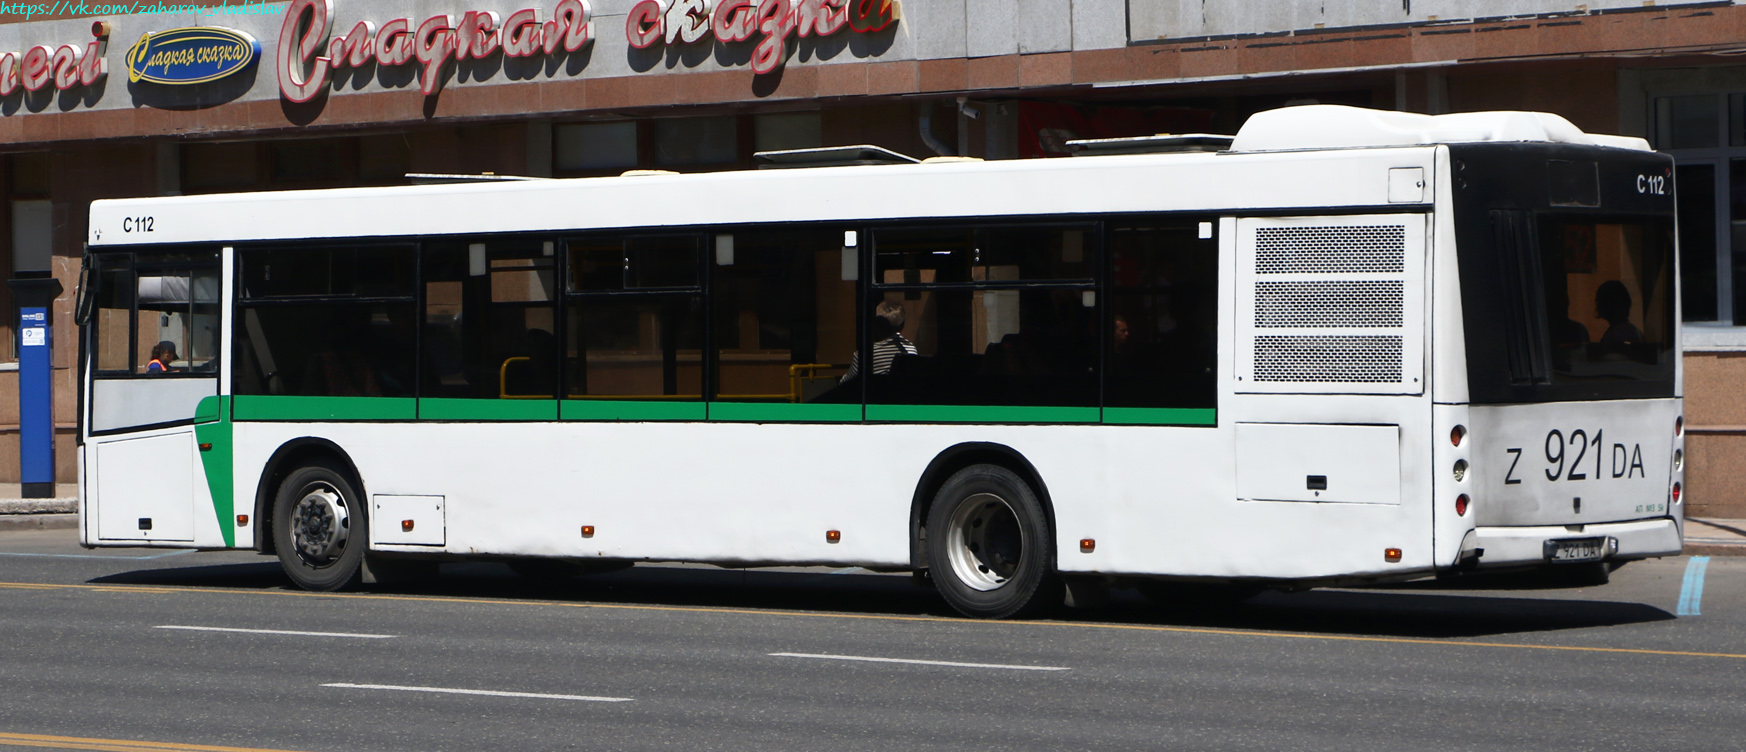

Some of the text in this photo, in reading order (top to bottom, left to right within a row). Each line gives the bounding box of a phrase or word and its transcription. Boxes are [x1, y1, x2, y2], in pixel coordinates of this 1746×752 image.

[129, 33, 242, 83] Сладкая сказка
[277, 0, 893, 103] Сладкая сказка
[1637, 174, 1665, 195] C 112
[123, 216, 154, 233] C 112
[1505, 428, 1645, 485] Z 921 DA
[1564, 543, 1580, 558] 921
